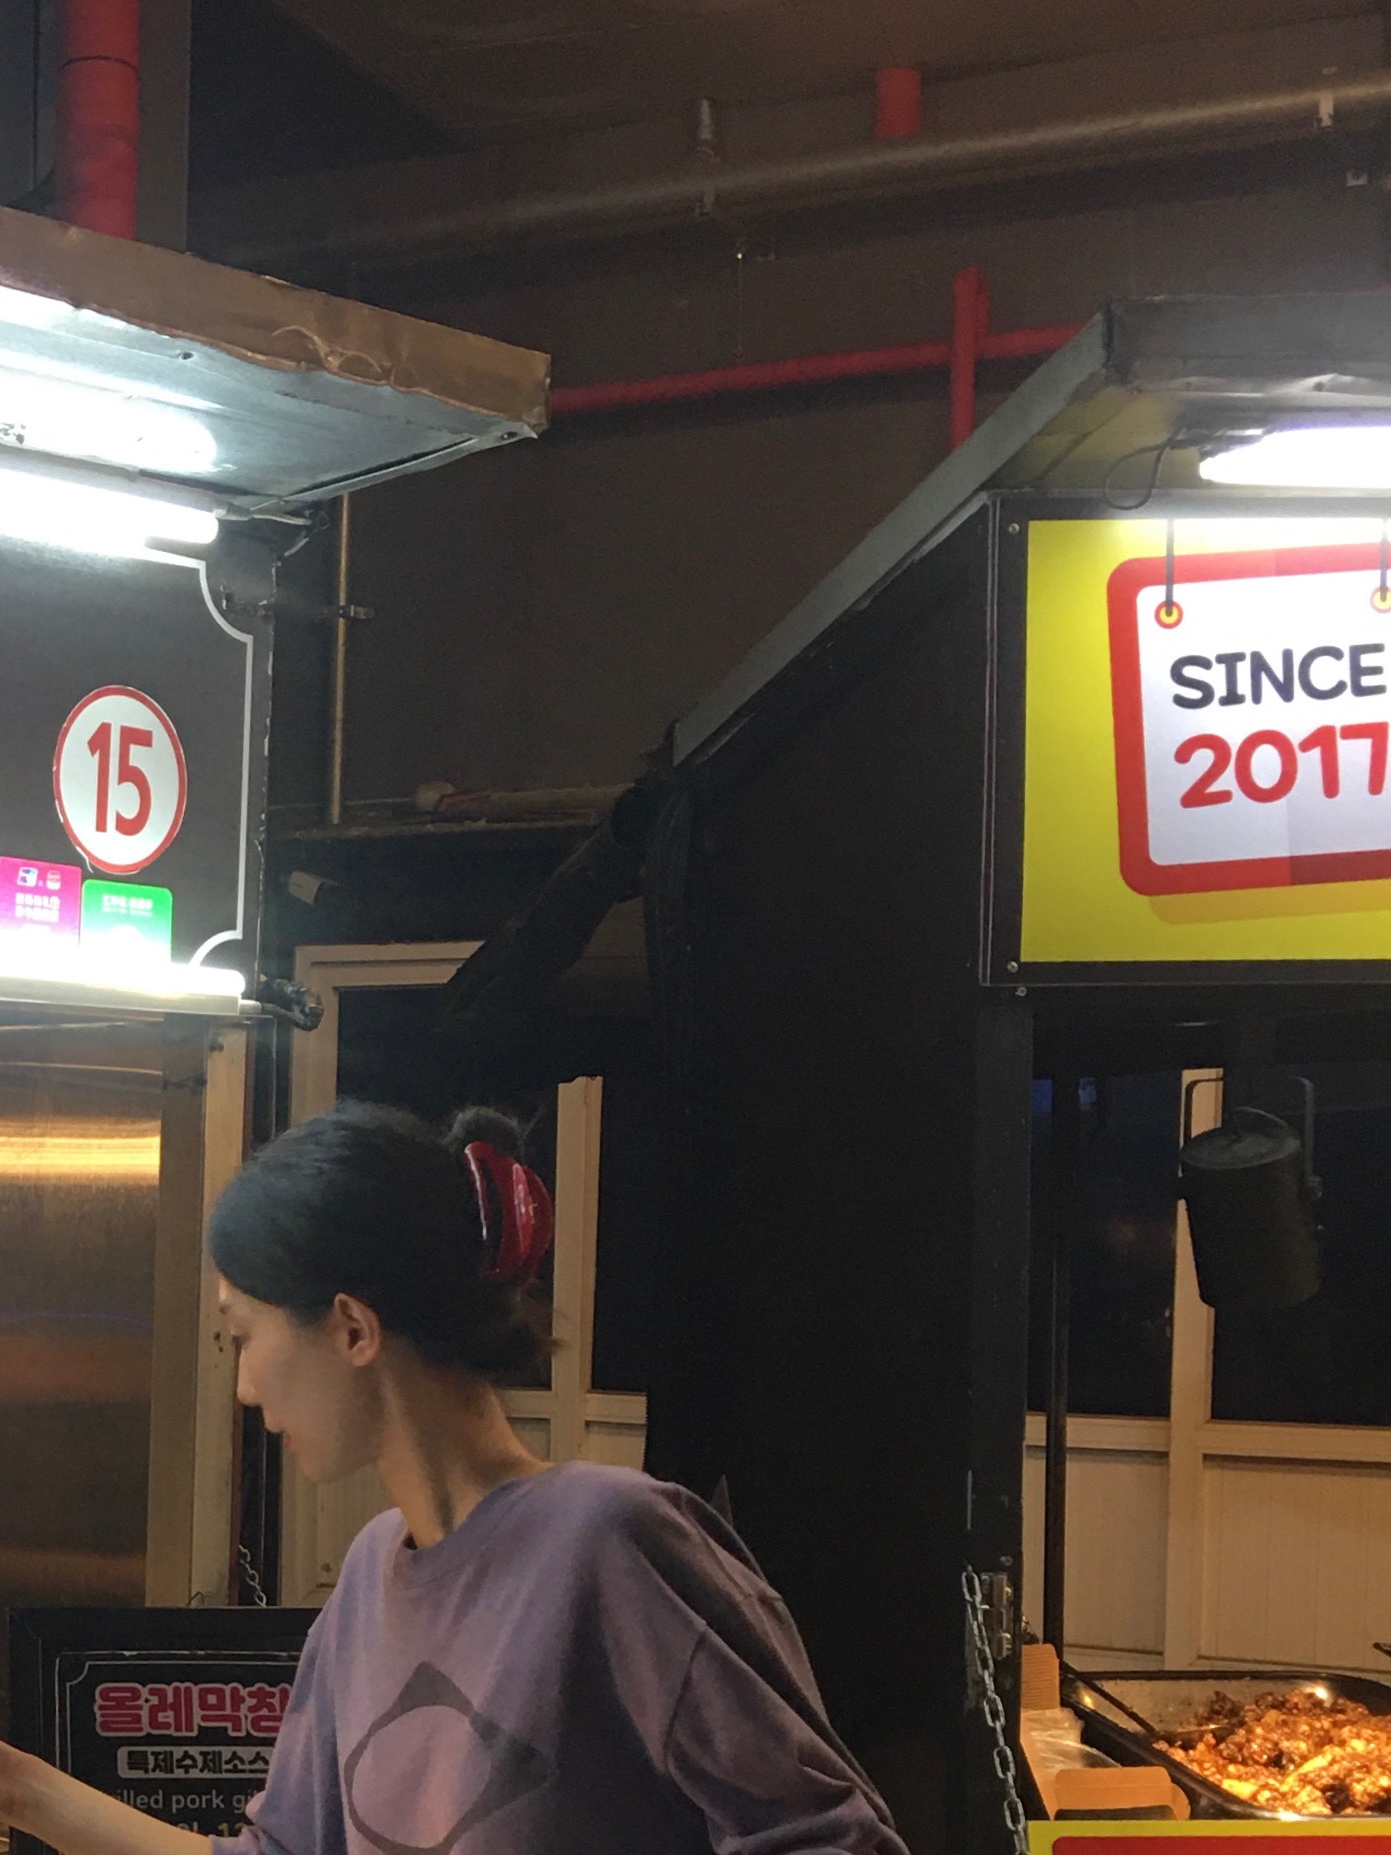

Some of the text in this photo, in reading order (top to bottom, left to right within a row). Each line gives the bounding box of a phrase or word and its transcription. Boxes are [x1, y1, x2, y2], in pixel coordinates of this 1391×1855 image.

[1170, 643, 1387, 709] SINCE
[87, 721, 153, 837] 15
[1174, 722, 1391, 809] 2017
[94, 1682, 295, 1737] 올레막창
[127, 1750, 271, 1775] 특제수제소스
[116, 1789, 163, 1810] illed
[172, 1789, 225, 1814] pork
